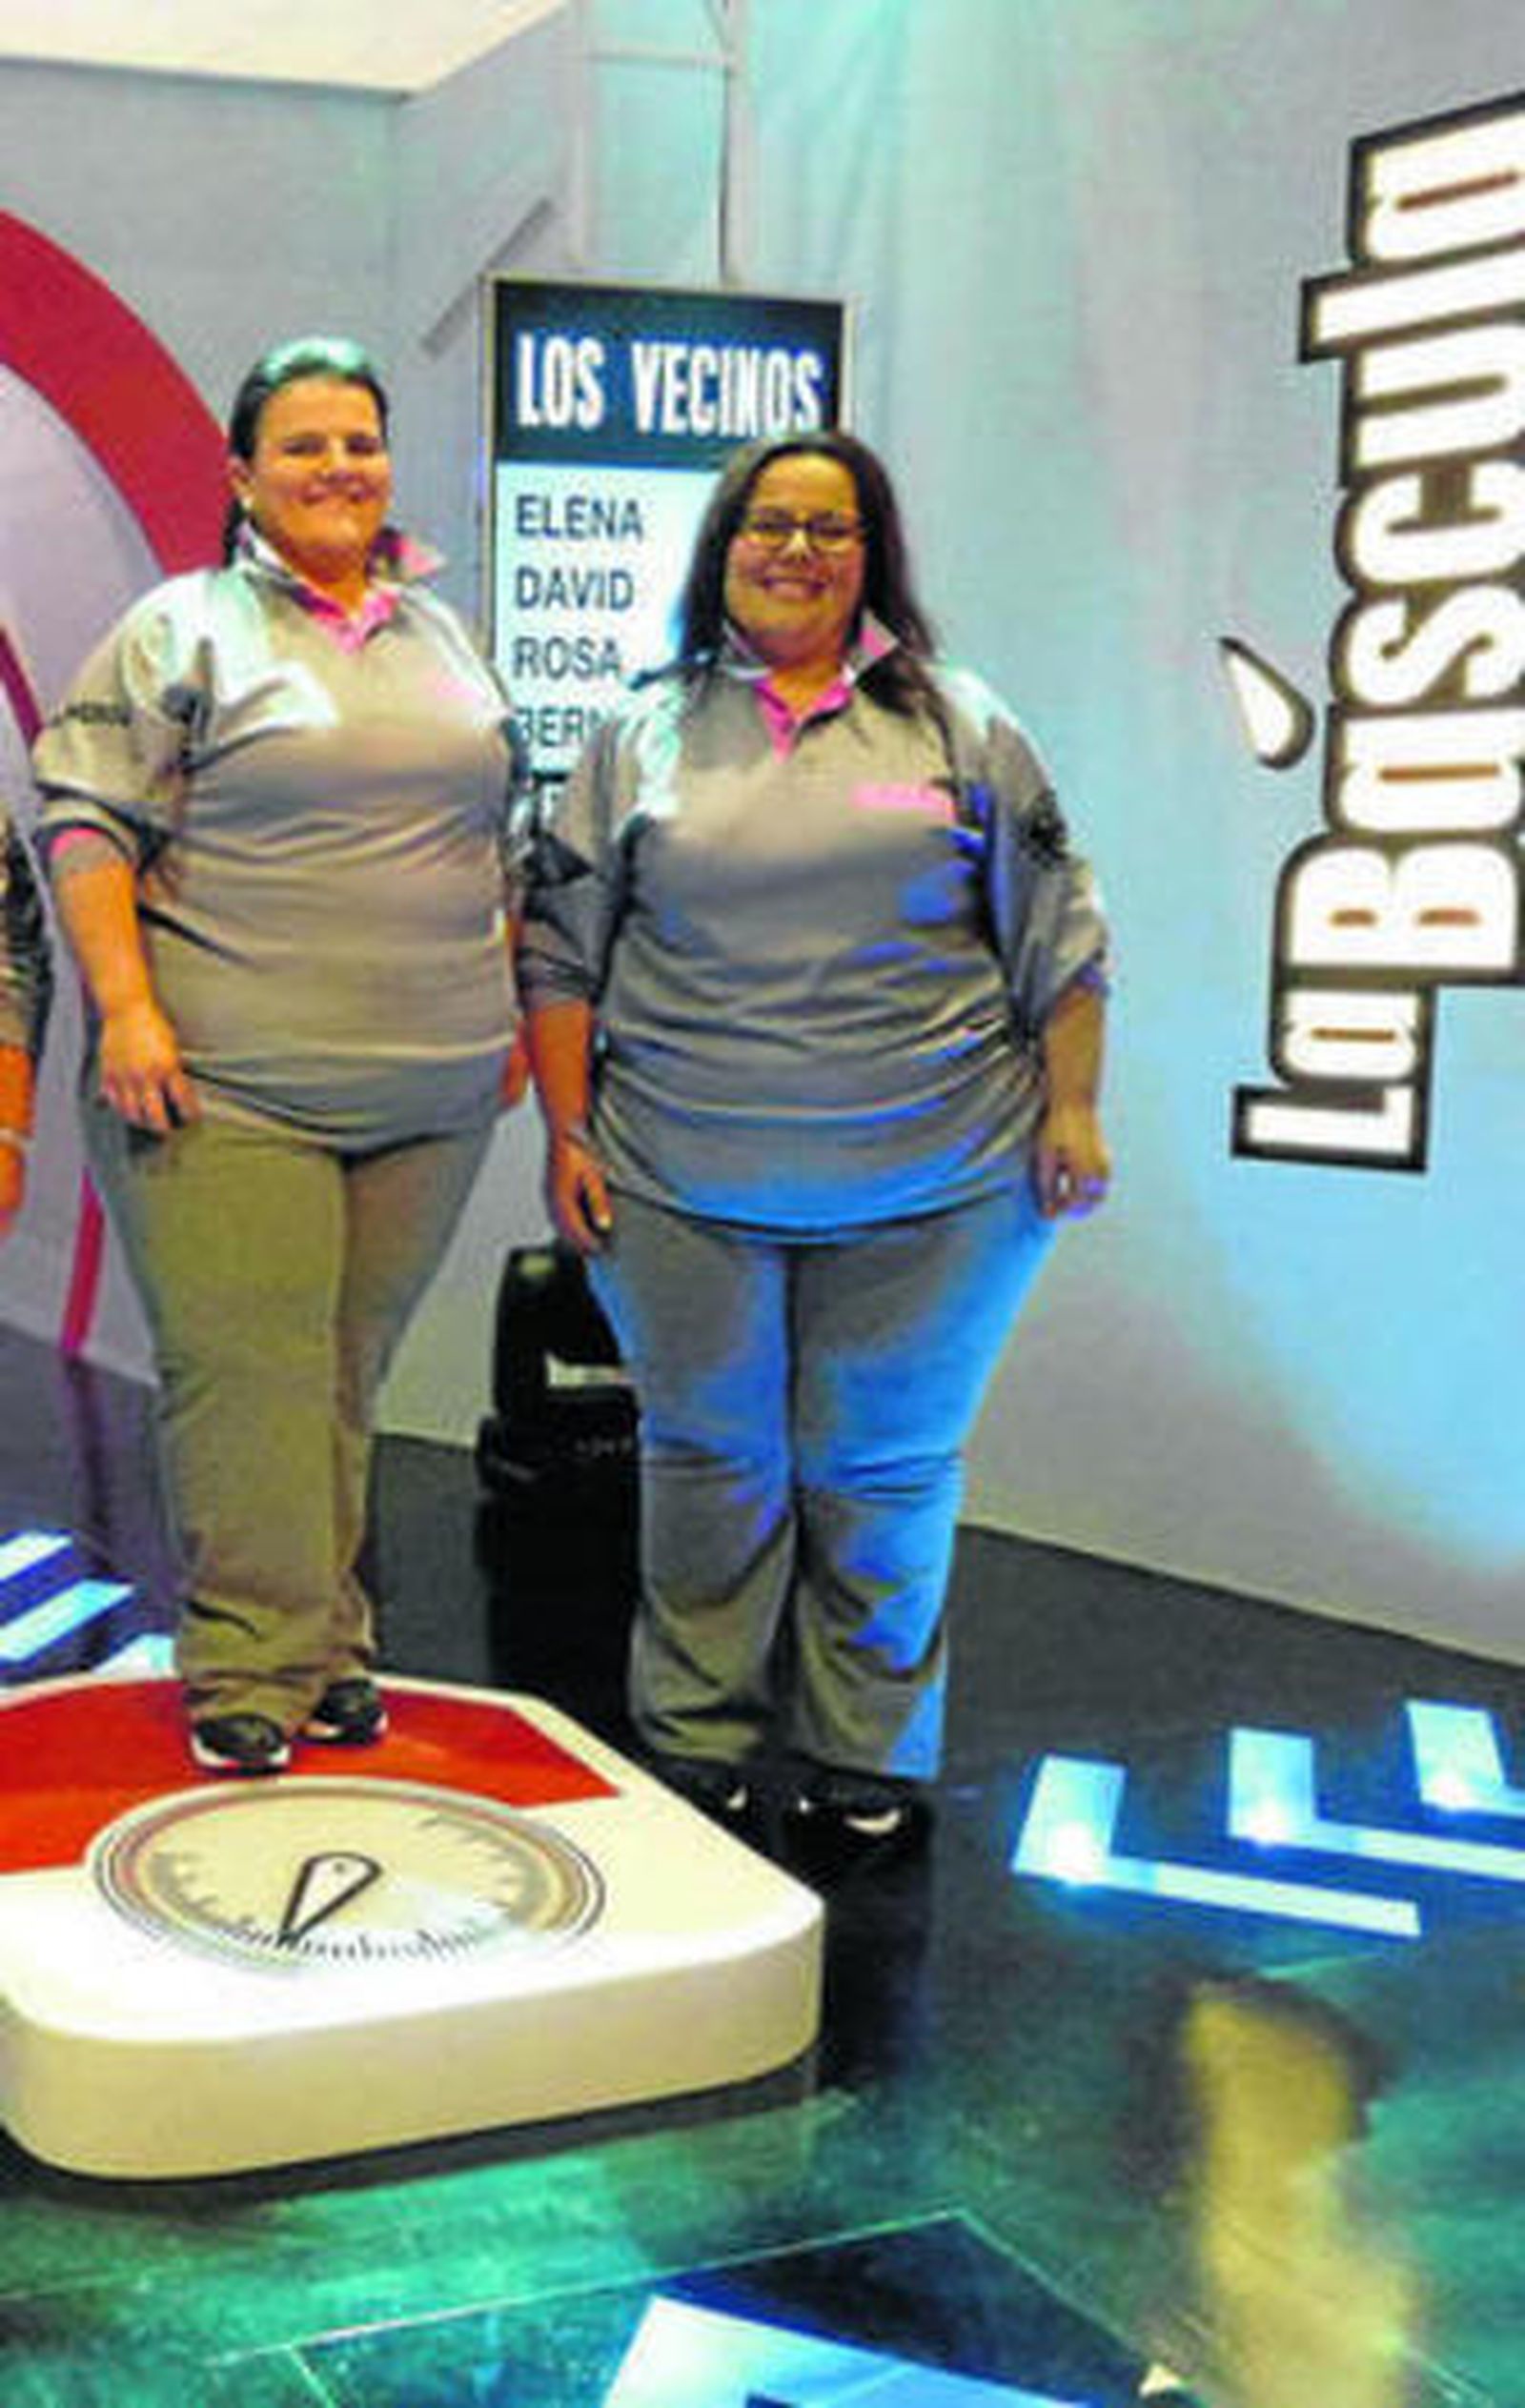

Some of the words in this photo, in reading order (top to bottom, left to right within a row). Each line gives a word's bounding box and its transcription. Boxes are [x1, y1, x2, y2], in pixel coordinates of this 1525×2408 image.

[518, 333, 605, 430] LOS
[631, 340, 823, 439] VECINOS
[516, 494, 644, 542] ELENA
[515, 565, 635, 611] DAVID
[513, 636, 623, 681] ROSA
[1234, 977, 1426, 1166] La
